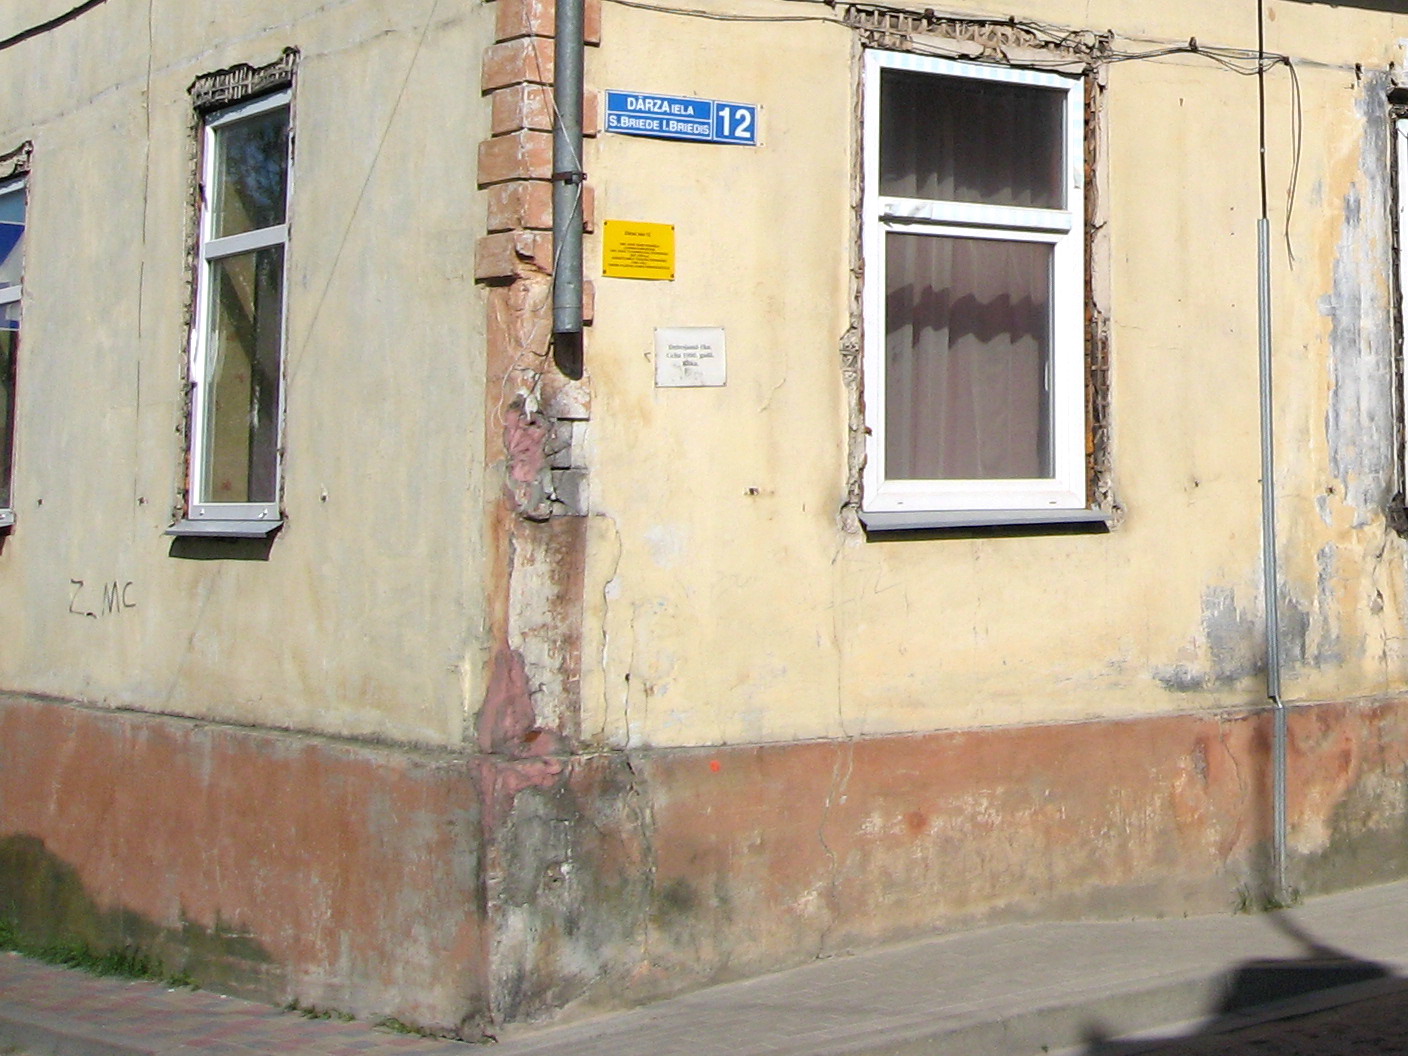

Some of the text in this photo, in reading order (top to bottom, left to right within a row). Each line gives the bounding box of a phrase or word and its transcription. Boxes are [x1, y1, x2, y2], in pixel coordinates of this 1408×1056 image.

[627, 96, 694, 115] DĀRZA IELA
[718, 107, 752, 138] 12
